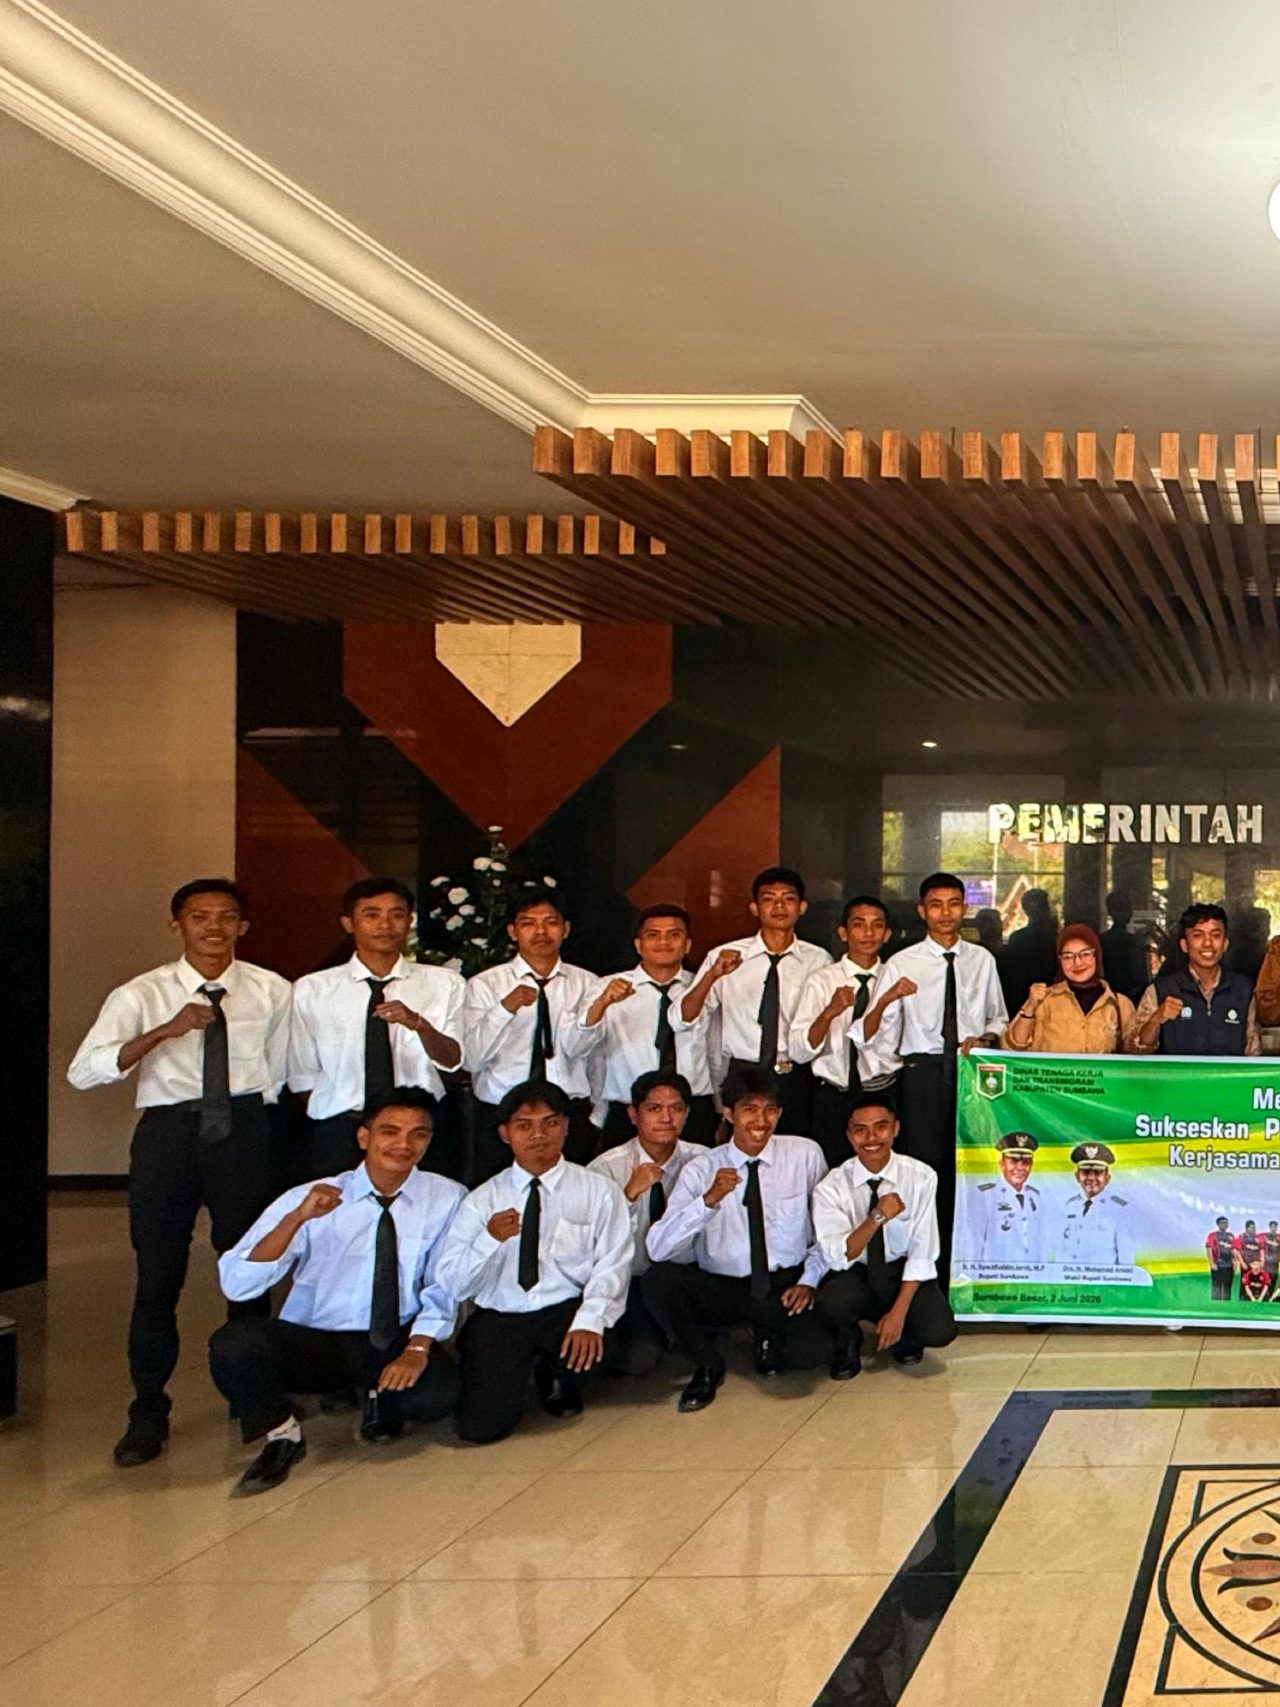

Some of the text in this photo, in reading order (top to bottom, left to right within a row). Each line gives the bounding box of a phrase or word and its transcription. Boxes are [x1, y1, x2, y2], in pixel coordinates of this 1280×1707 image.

[987, 802, 1263, 845] PEMERINTAH
[1041, 1069, 1075, 1077] TENAGA
[1076, 1069, 1104, 1078] KERJA
[1063, 1087, 1105, 1095] SUMBAWA
[1135, 1114, 1249, 1139] Sukseskan
[1058, 1295, 1078, 1304] Juni
